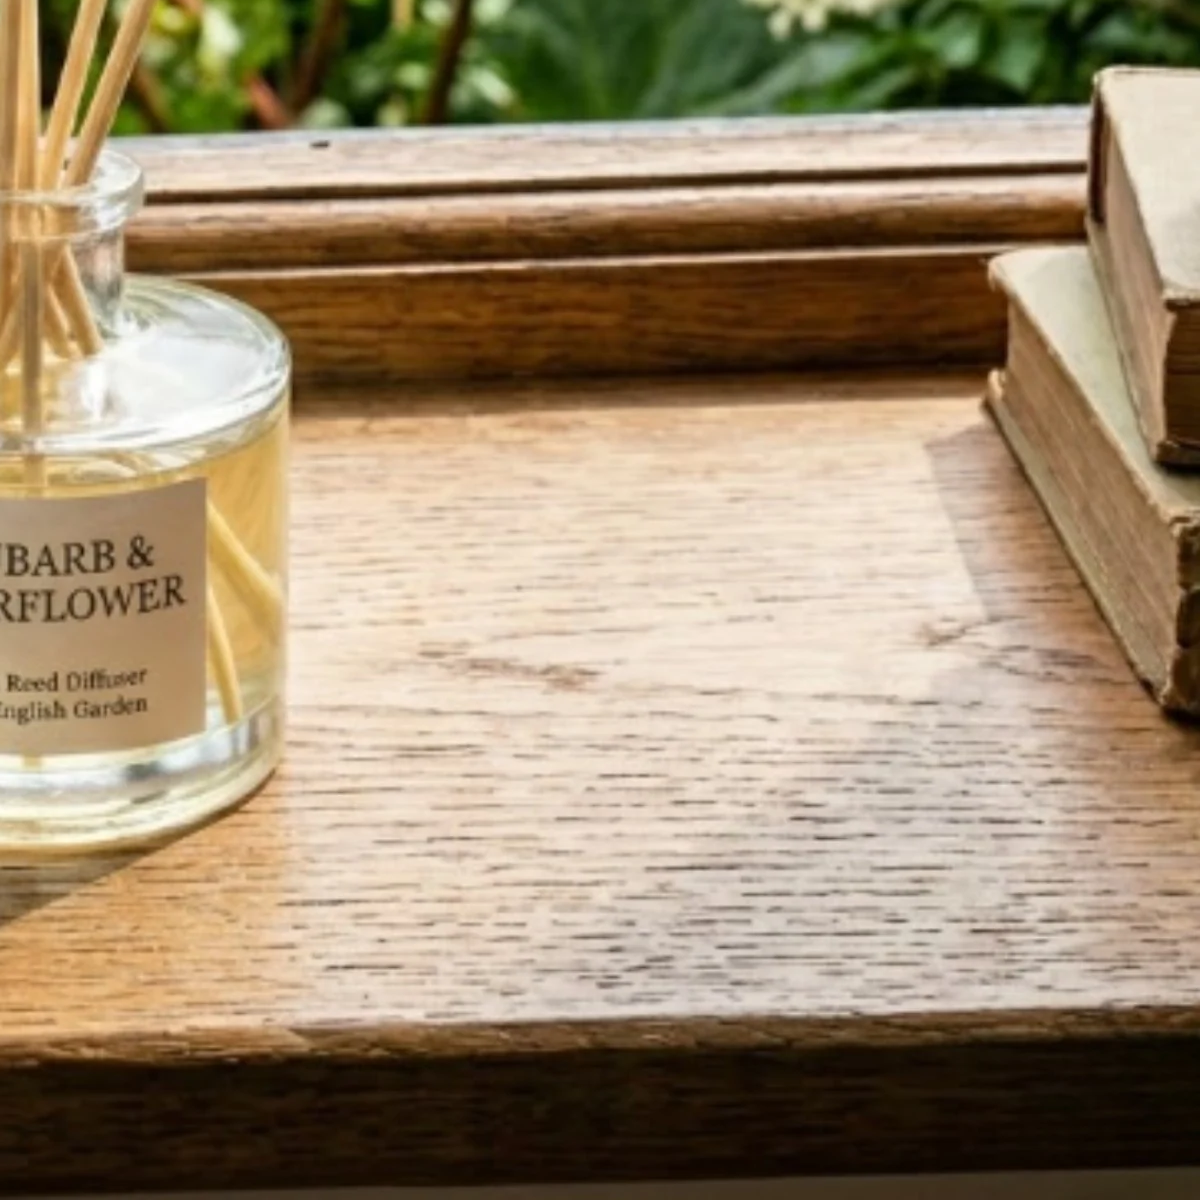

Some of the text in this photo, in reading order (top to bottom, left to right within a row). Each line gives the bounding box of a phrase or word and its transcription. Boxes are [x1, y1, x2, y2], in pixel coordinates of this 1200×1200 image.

[126, 534, 154, 568] &
[6, 672, 59, 693] Reed
[67, 667, 147, 691] Diffuser
[73, 695, 148, 720] Garden
